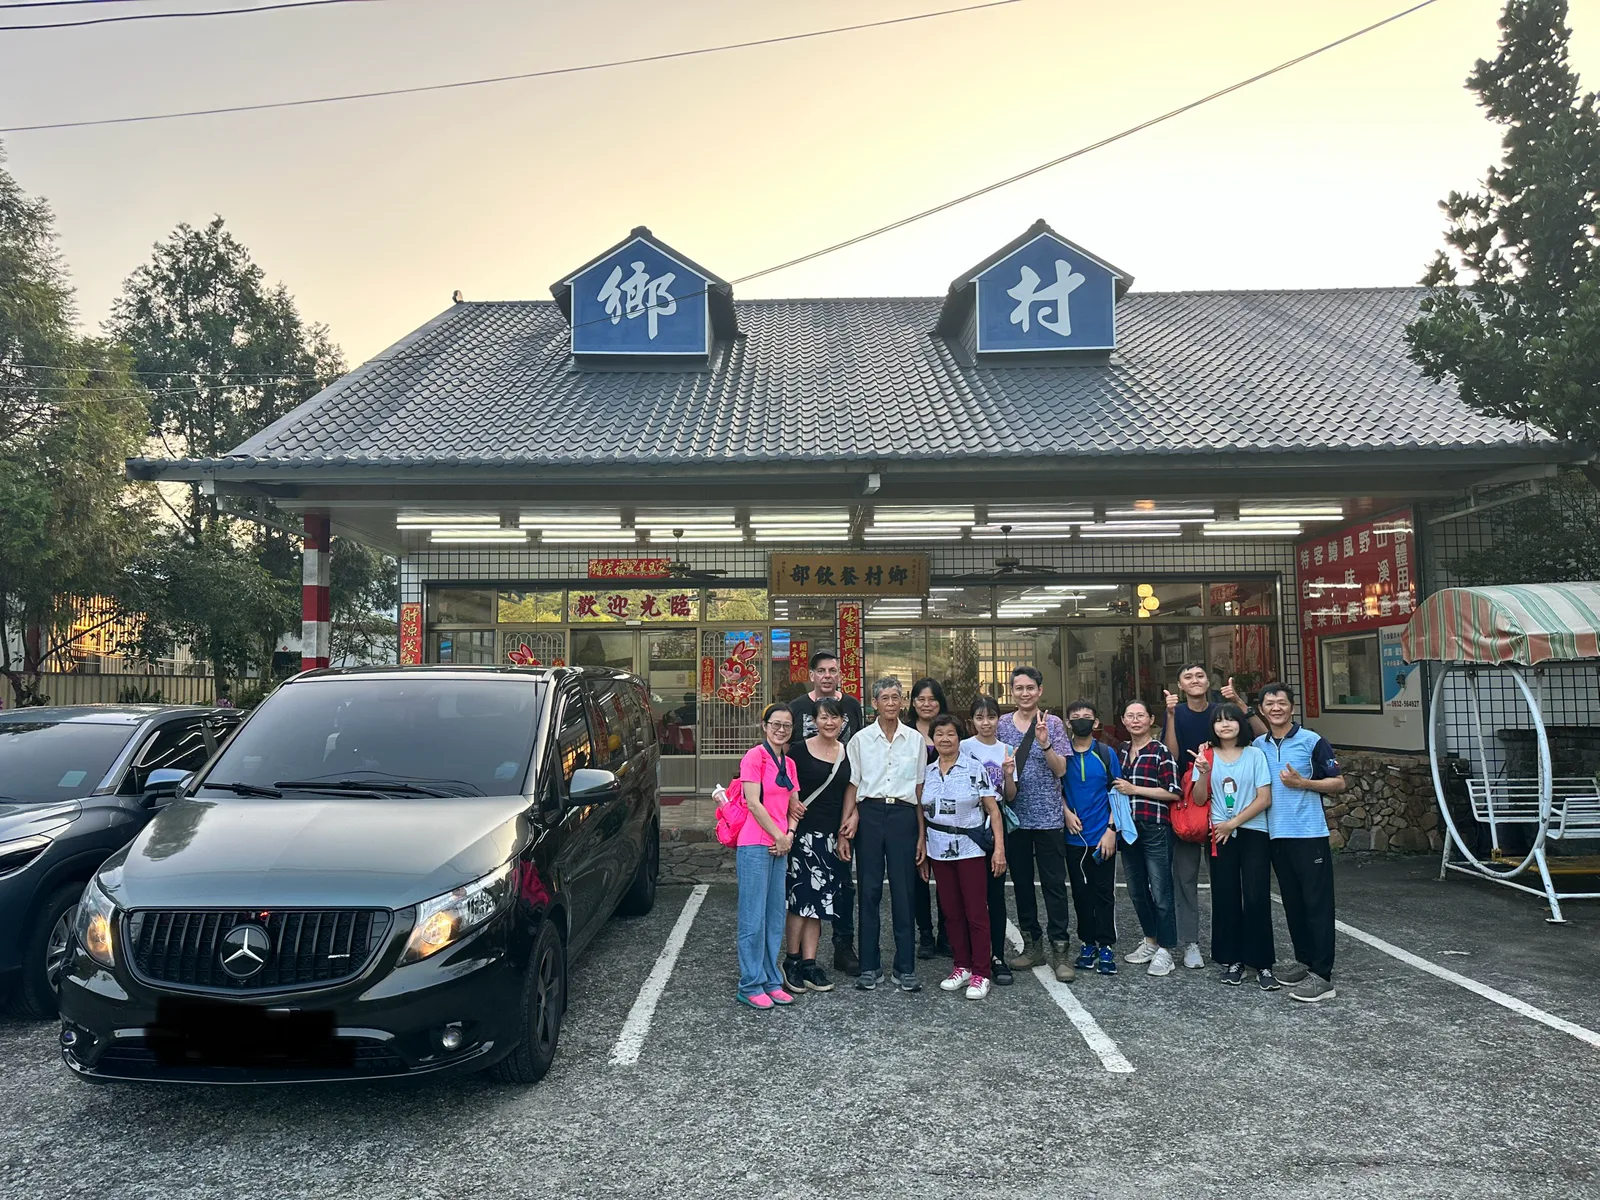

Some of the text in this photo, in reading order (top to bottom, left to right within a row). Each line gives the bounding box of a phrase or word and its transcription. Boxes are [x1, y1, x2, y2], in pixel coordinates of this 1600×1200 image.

[597, 260, 678, 340] 鄉
[1006, 258, 1086, 338] 村
[576, 594, 692, 618] 歡迎光臨
